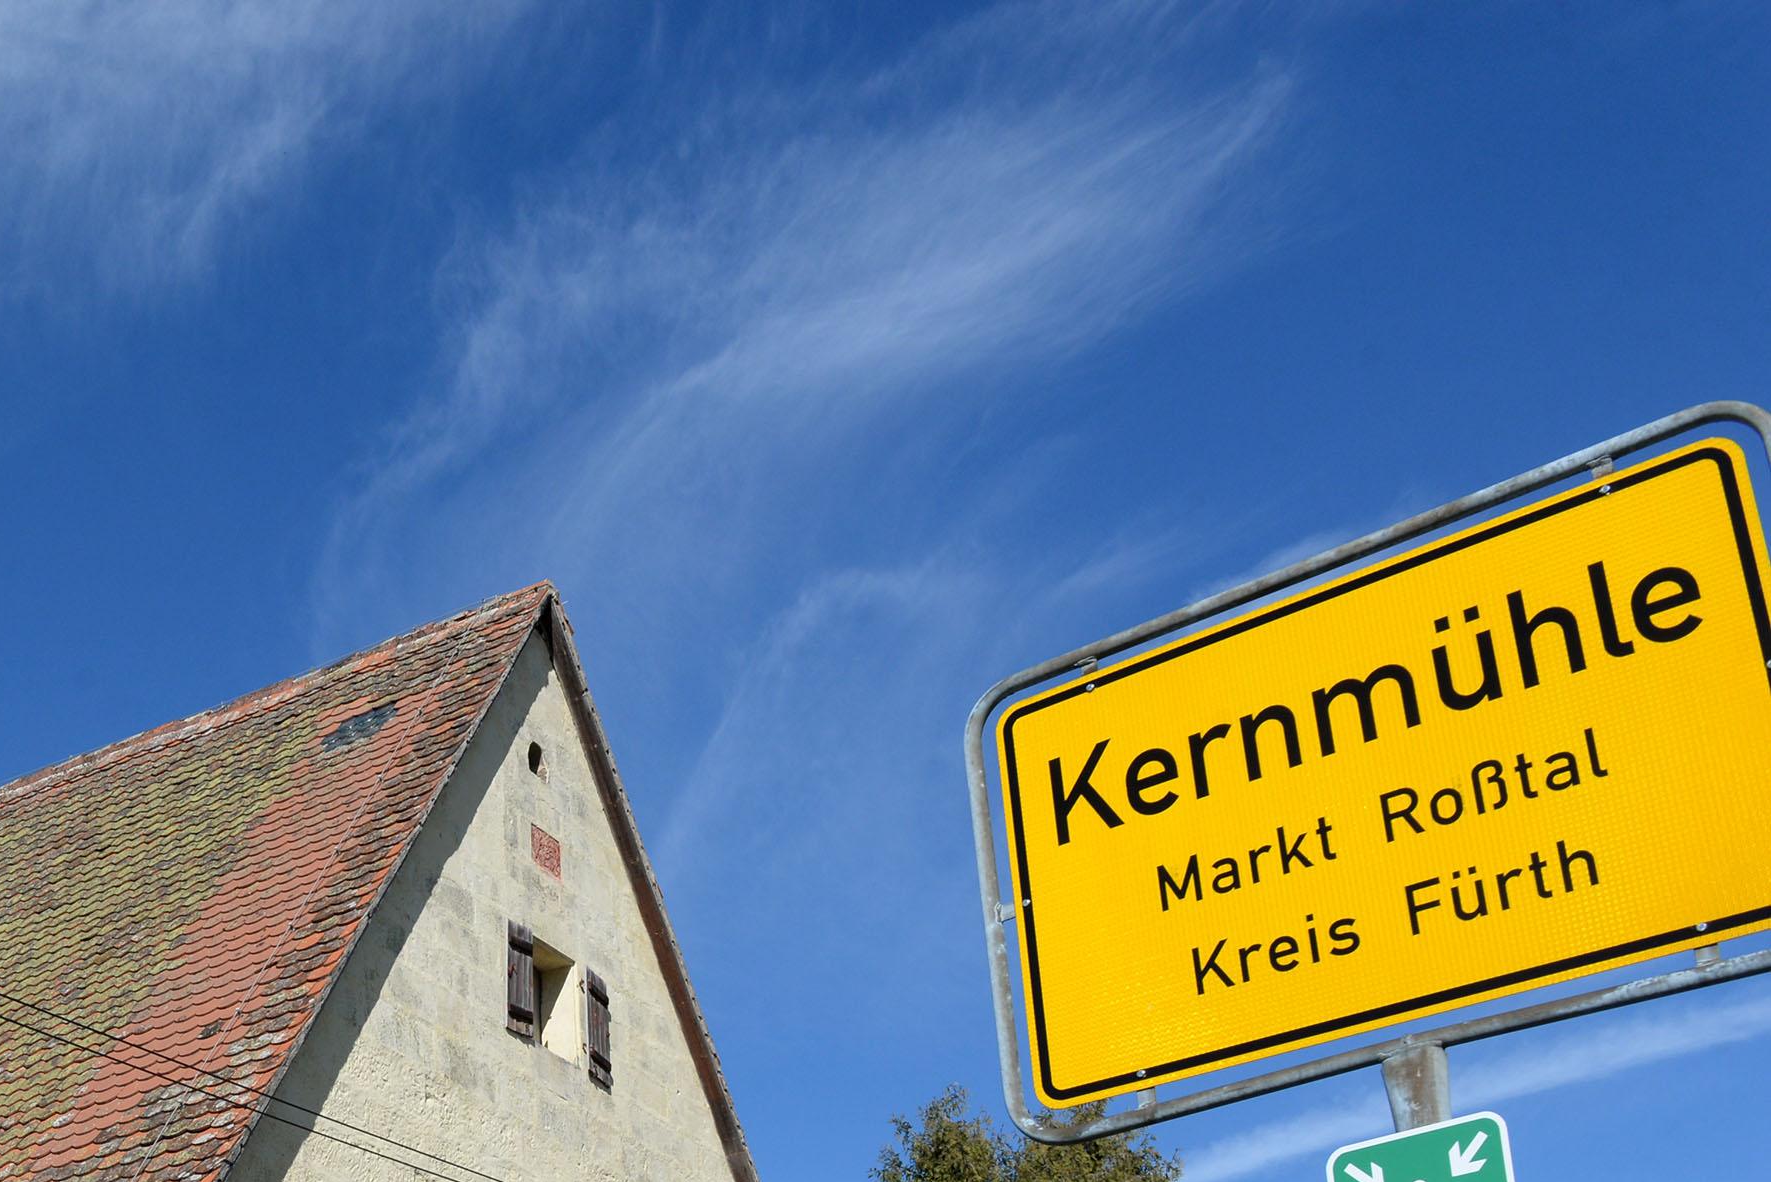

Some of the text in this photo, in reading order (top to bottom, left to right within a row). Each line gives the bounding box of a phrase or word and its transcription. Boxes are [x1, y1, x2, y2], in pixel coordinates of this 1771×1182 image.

[1048, 561, 1702, 846] Kernmühle
[1156, 727, 1608, 912] Markt Roßtal
[1191, 840, 1599, 995] Kreis Fürth
